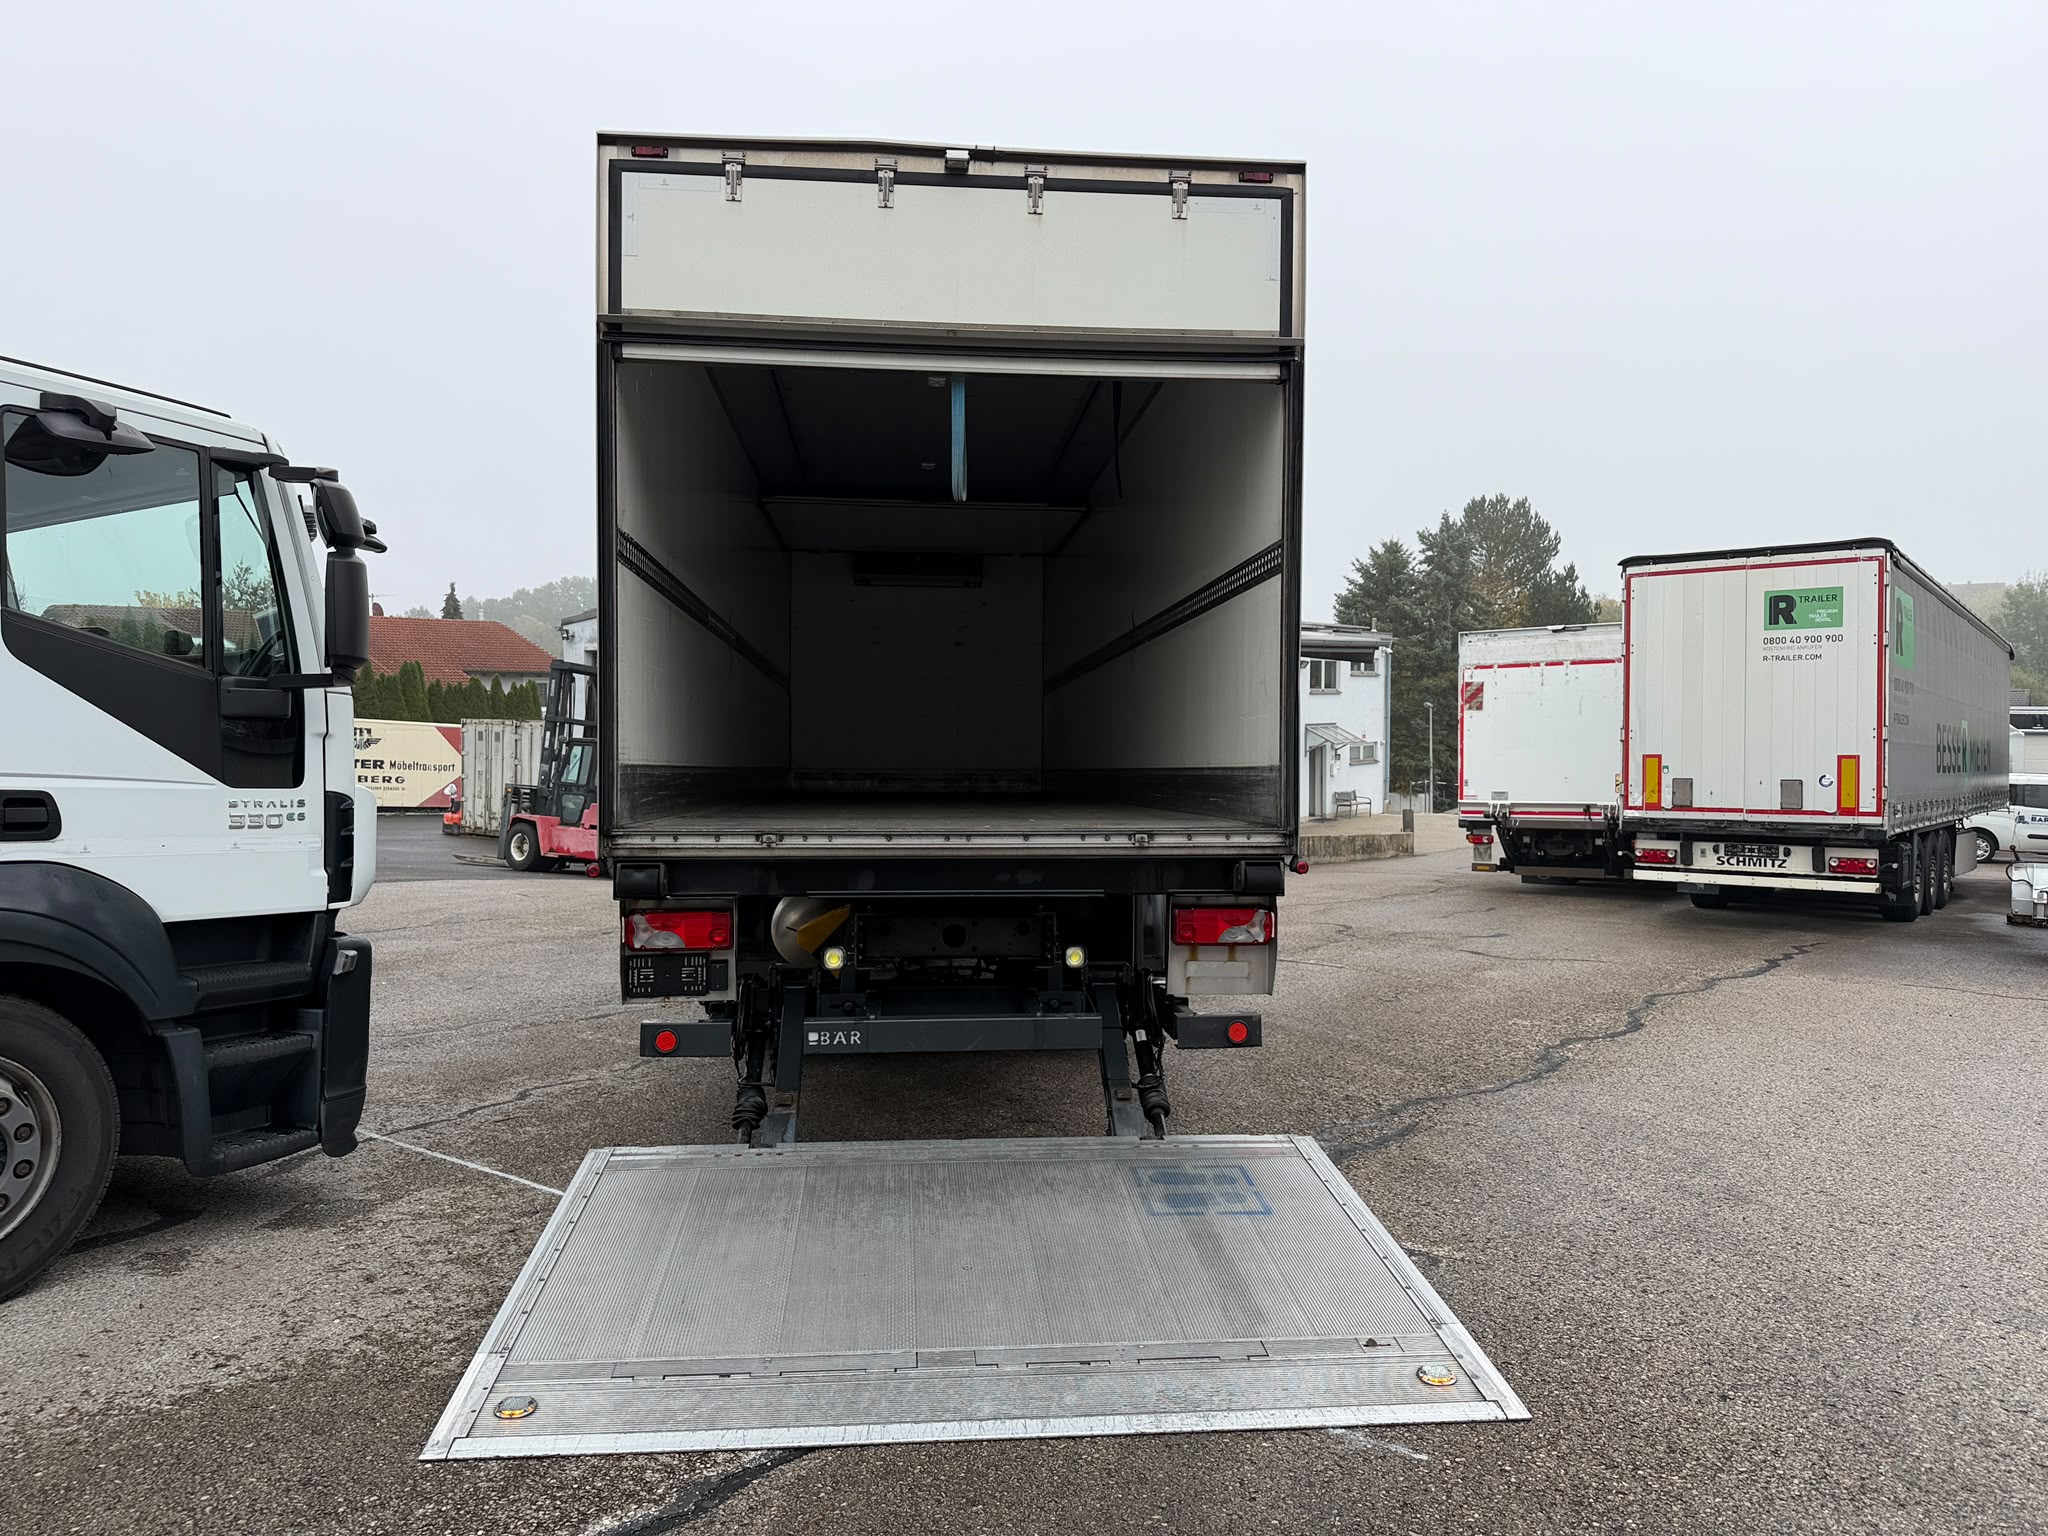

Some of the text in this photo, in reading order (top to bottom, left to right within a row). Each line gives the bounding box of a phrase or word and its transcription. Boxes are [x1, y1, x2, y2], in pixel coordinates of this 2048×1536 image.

[1798, 594, 1838, 604] TRAILER
[1769, 595, 1797, 626] R
[1763, 633, 1844, 645] 0800 40 900 900
[1762, 653, 1822, 662] R-TRAILER.COM
[357, 775, 406, 784] BERG
[228, 799, 306, 808] STRALIS
[1716, 856, 1788, 868] SCHMITZ
[820, 1031, 861, 1045] BÄR
